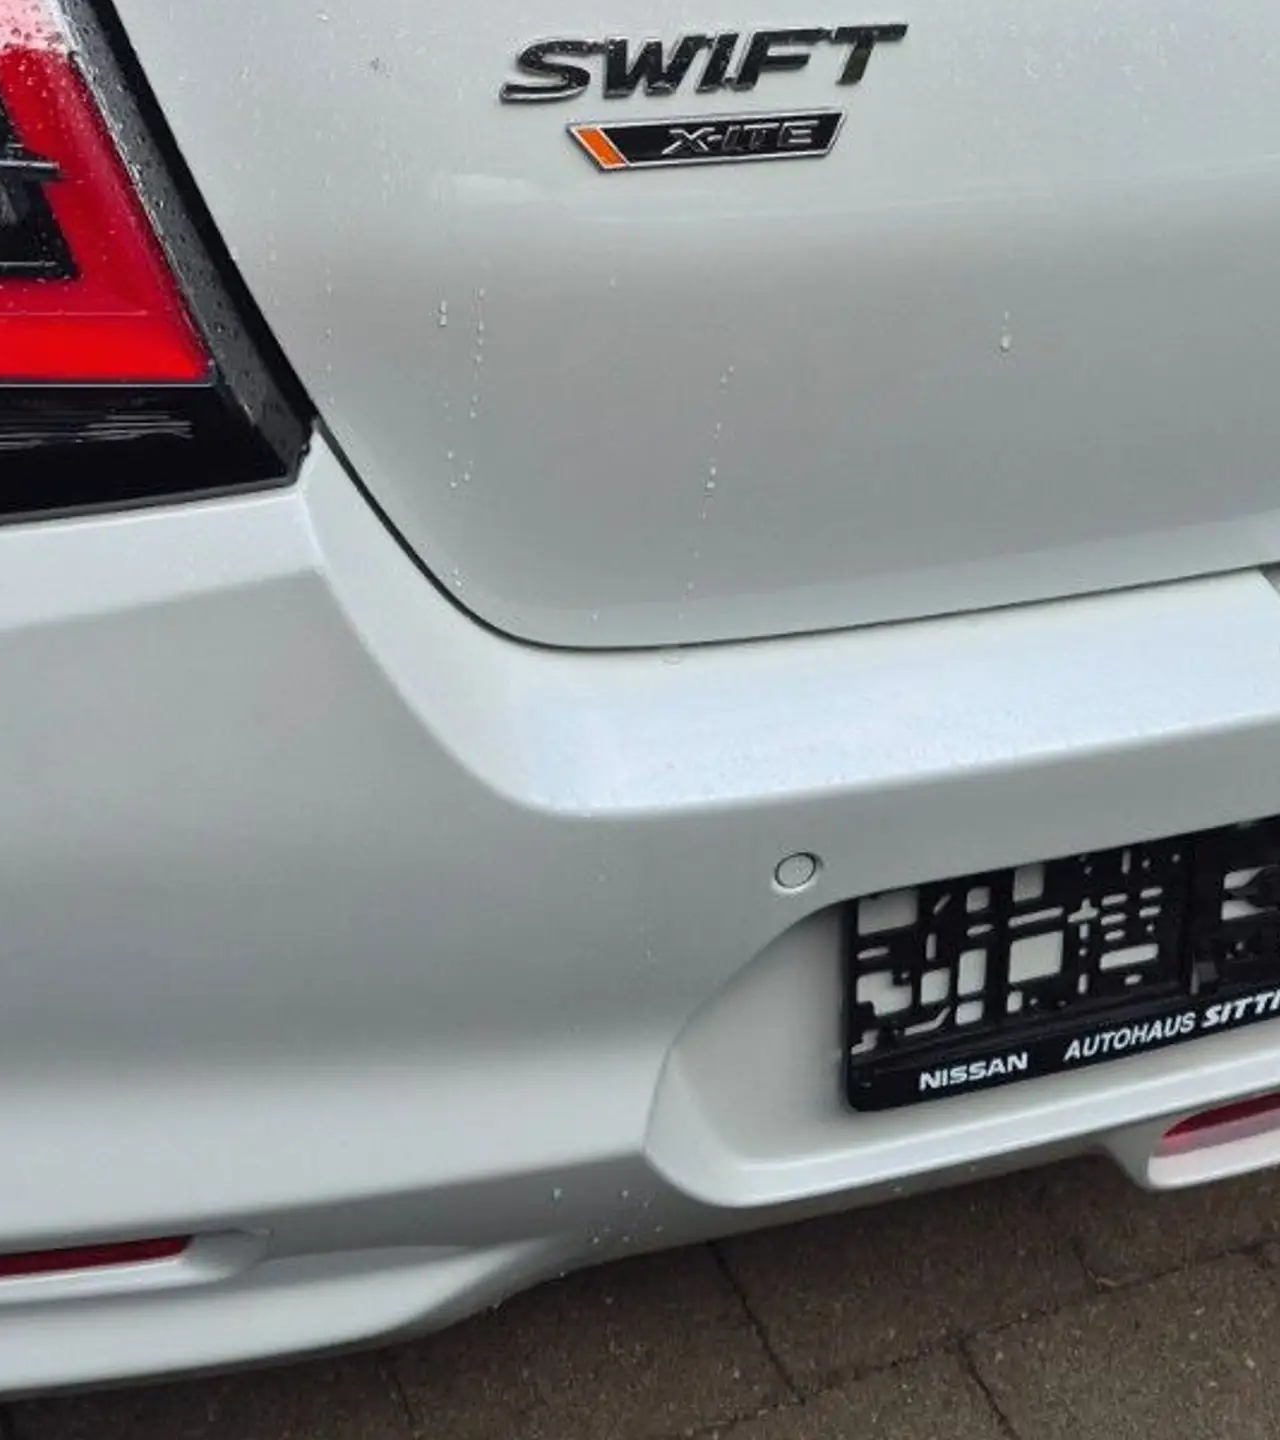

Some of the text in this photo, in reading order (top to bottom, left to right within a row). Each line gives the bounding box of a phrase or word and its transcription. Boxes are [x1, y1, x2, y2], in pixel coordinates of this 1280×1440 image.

[499, 23, 909, 104] SWIFT
[661, 119, 819, 156] X-ITE
[919, 1051, 1028, 1091] NISSAN
[1063, 1012, 1196, 1060] AUTOHAUS
